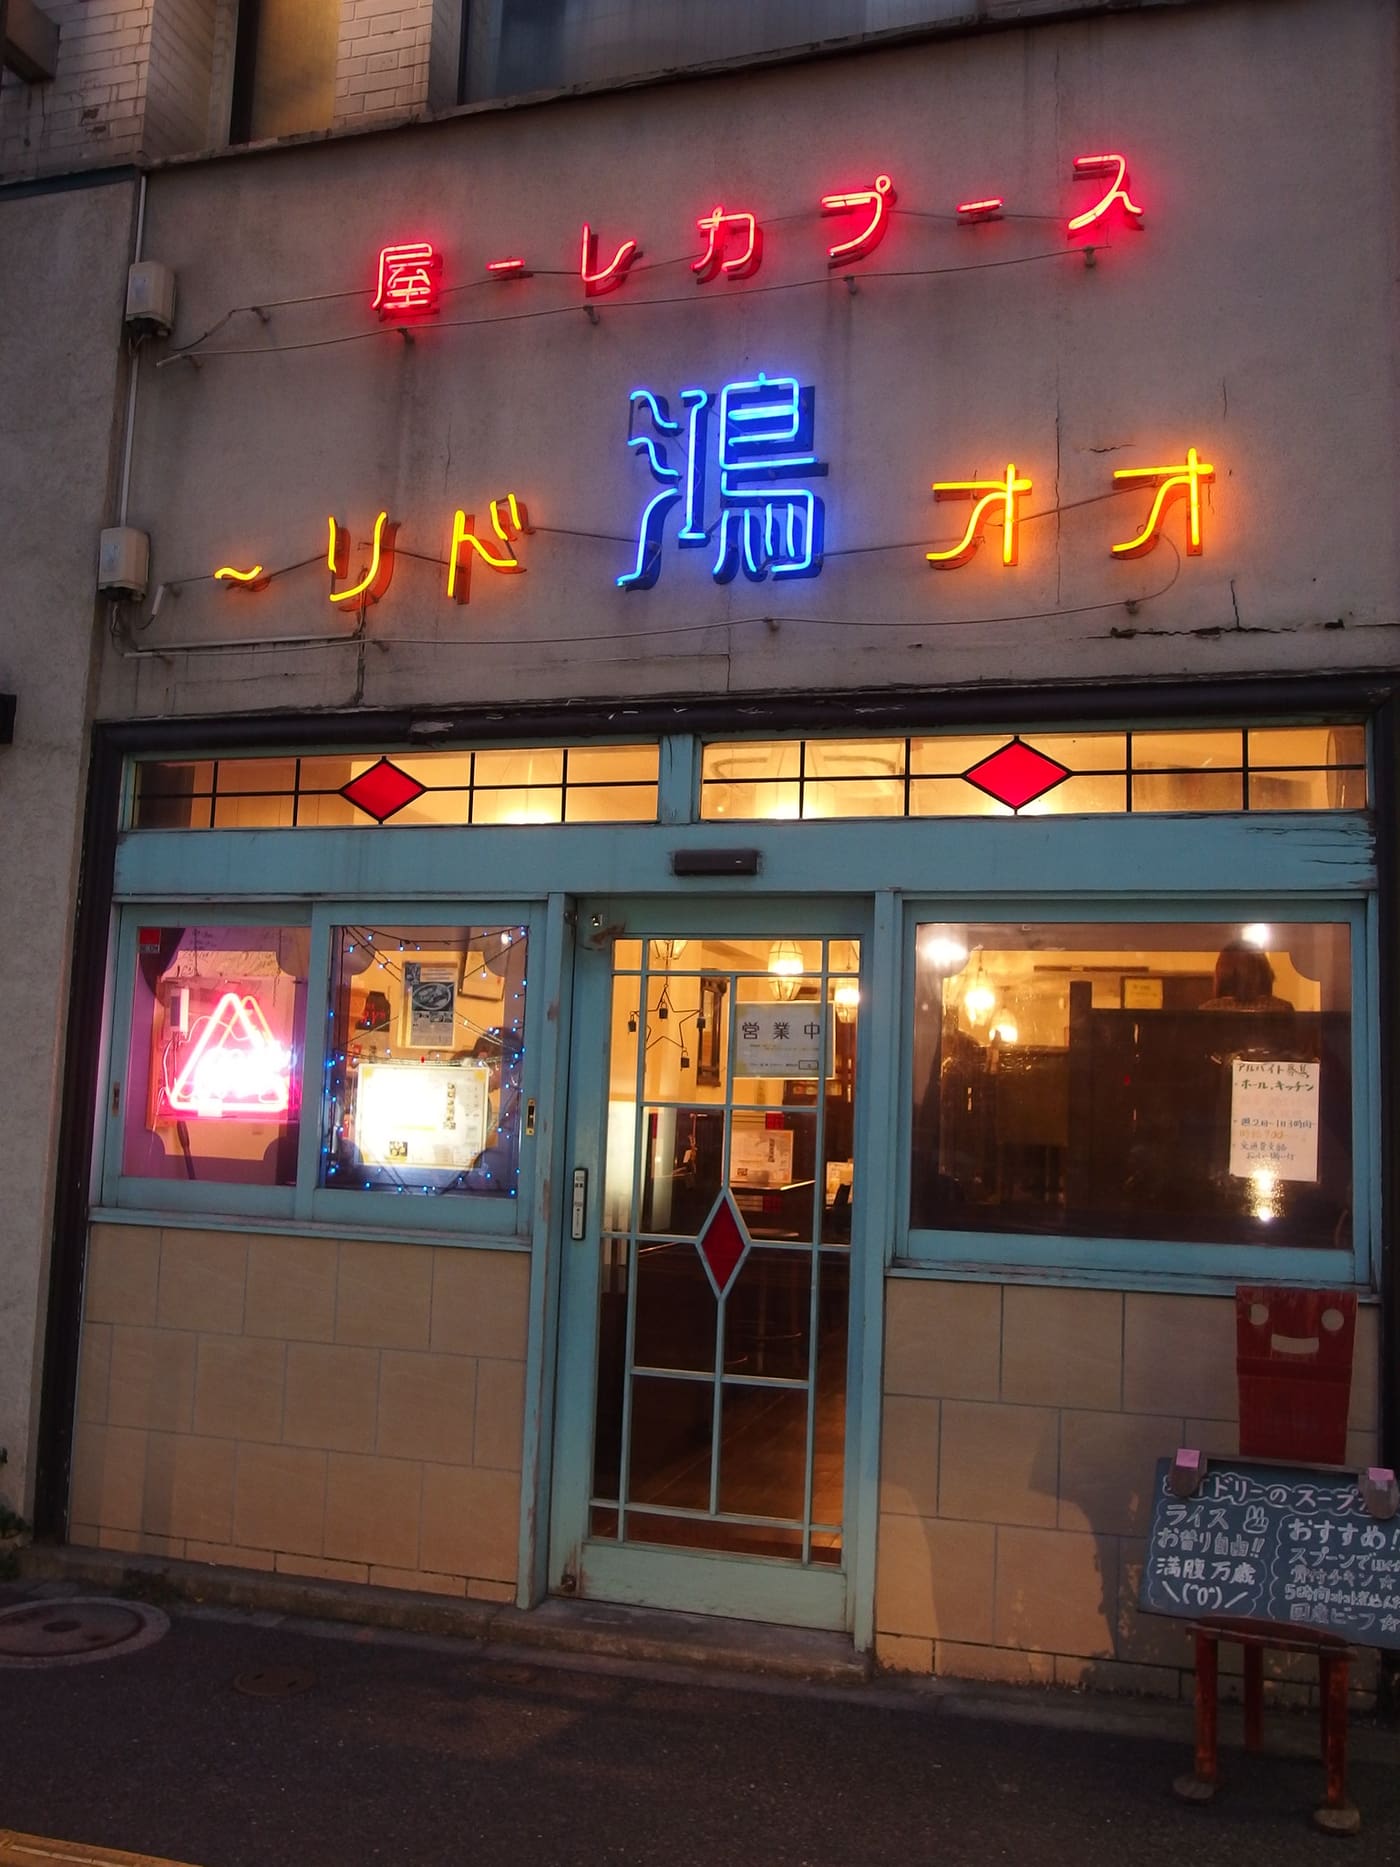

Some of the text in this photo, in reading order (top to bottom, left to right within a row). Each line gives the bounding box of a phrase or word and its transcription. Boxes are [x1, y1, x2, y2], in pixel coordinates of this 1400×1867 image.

[615, 371, 819, 588] 鴻
[741, 1020, 821, 1041] 営業中
[1166, 1504, 1229, 1530] ライス
[1155, 1555, 1257, 1585] 満腹万歳
